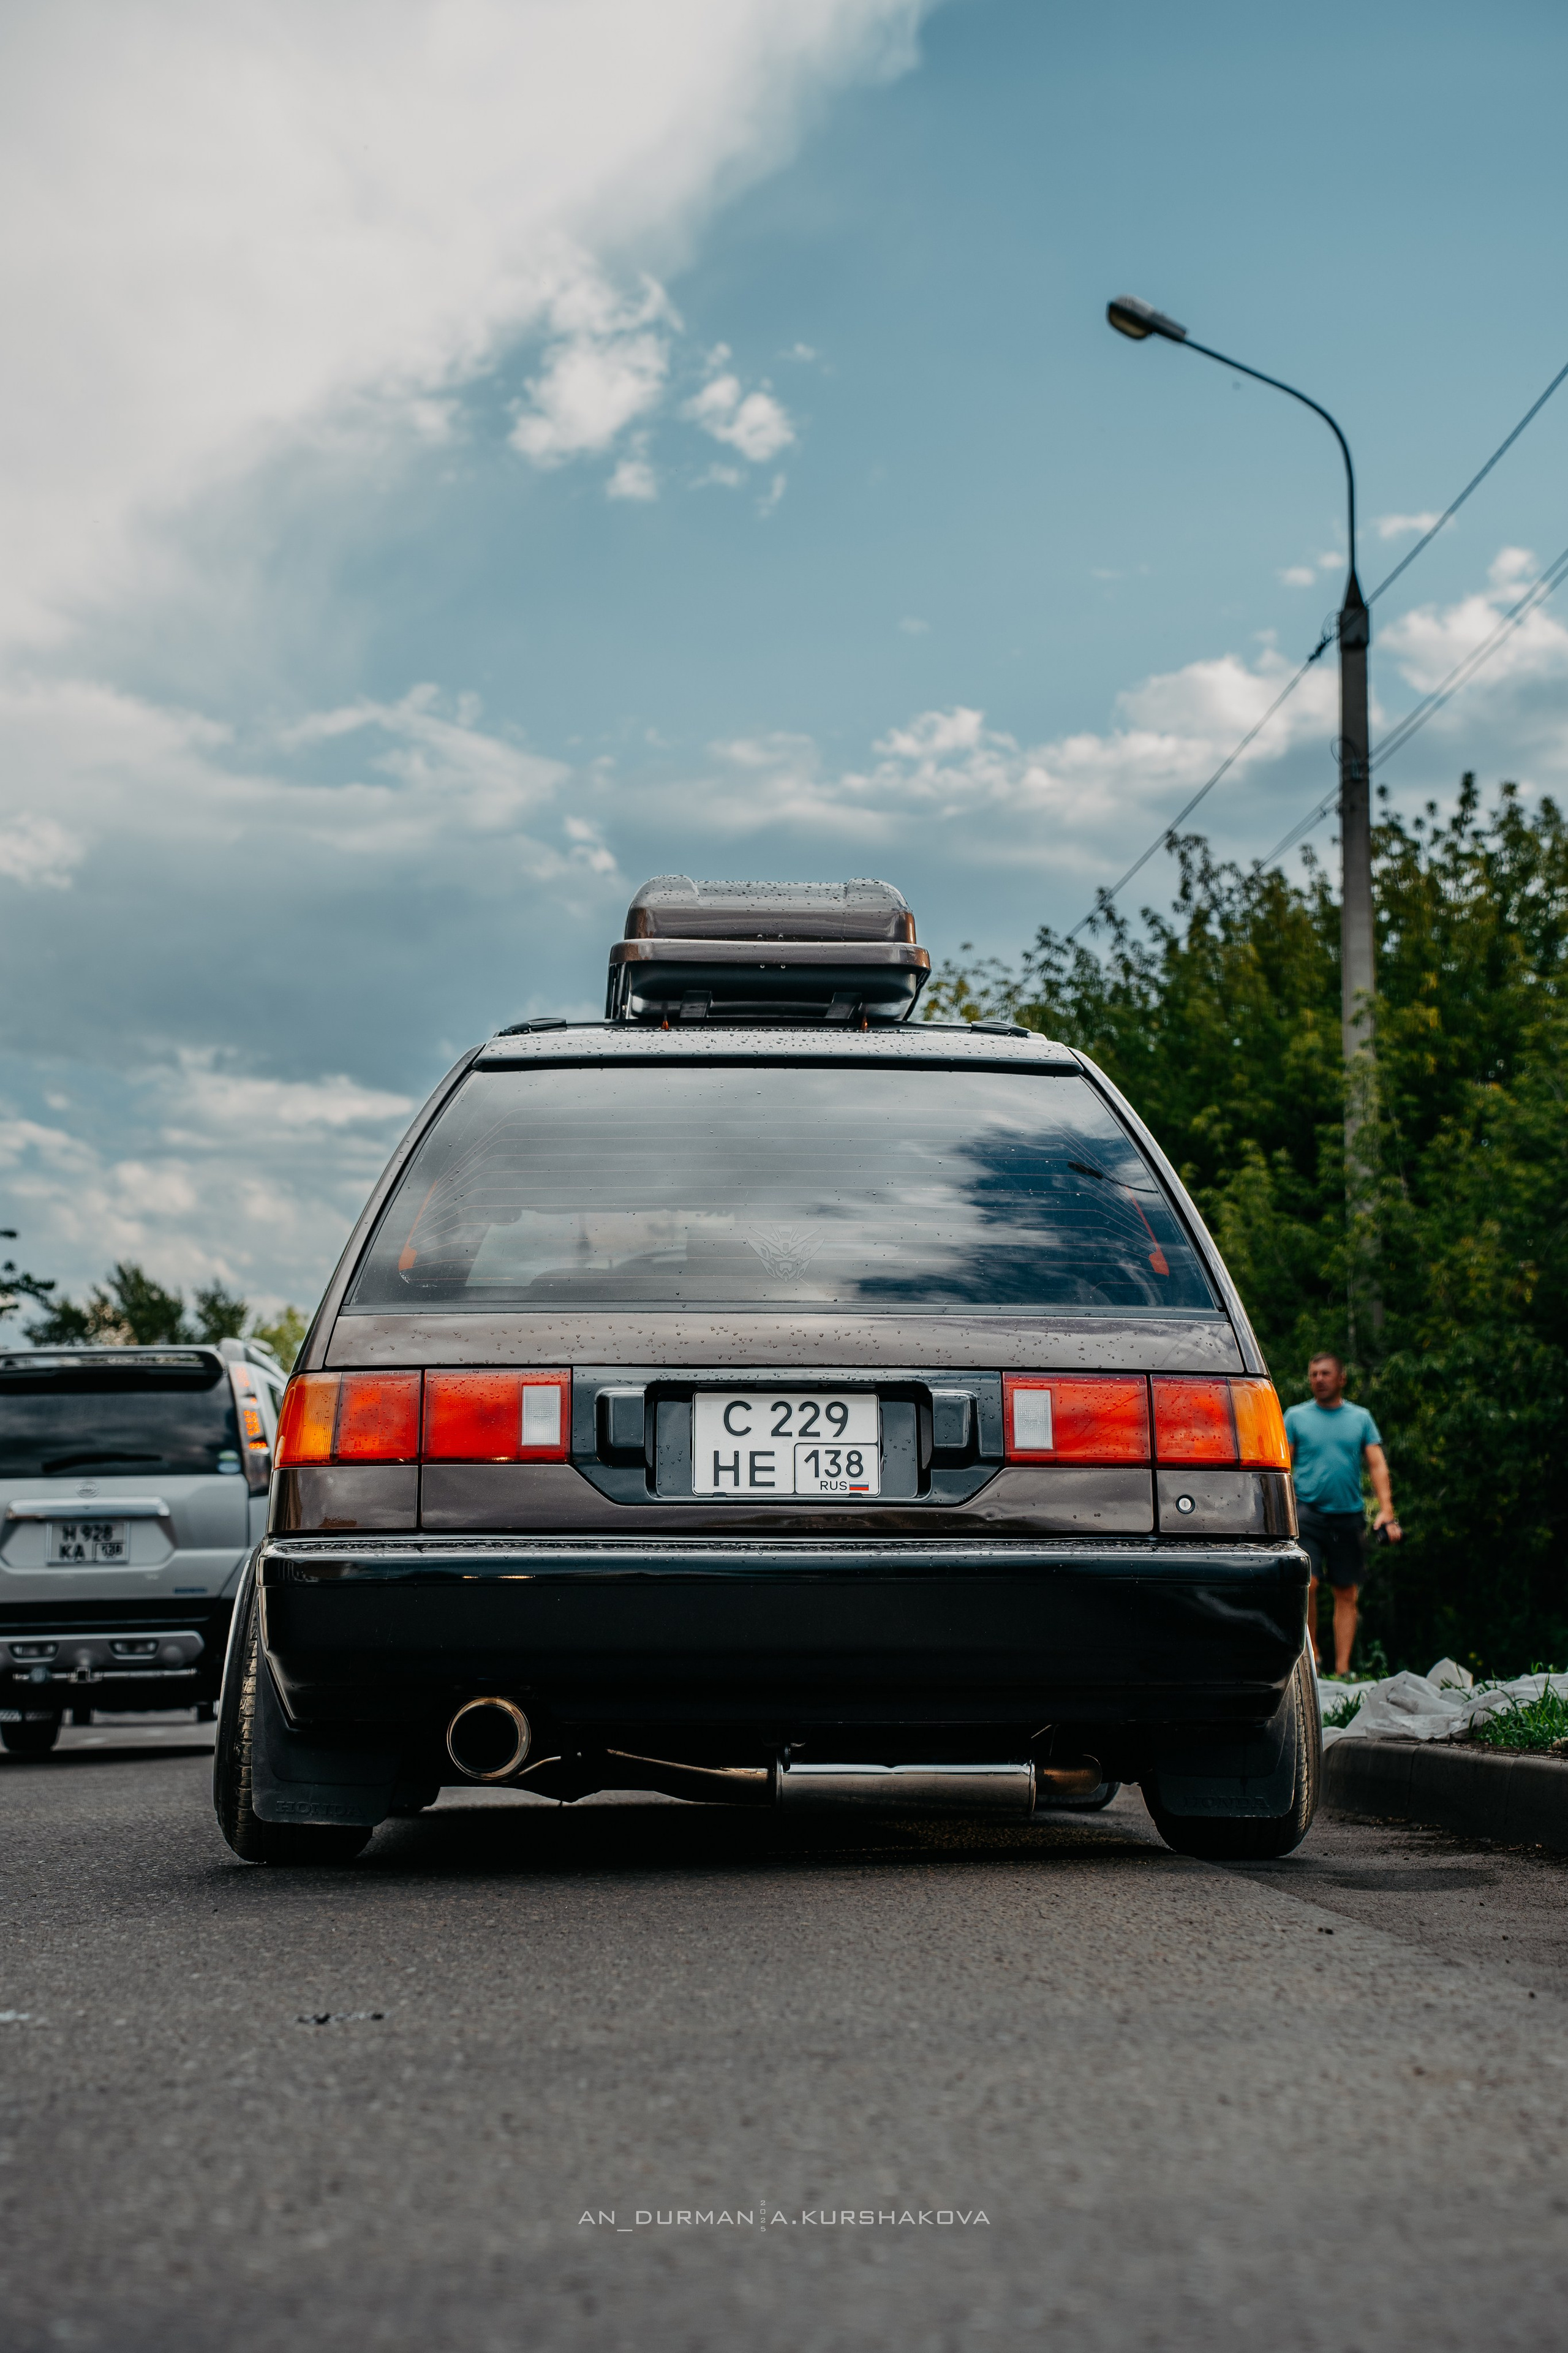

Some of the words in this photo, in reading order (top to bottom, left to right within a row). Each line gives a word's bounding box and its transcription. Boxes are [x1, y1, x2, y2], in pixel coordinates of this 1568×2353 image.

[723, 1400, 752, 1437] C
[771, 1400, 848, 1437] 229
[713, 1450, 775, 1487] HE
[804, 1449, 864, 1478] 138
[820, 1481, 847, 1490] RUS
[59, 1543, 85, 1561] KA
[276, 1800, 366, 1818] HONDA
[1184, 1795, 1270, 1810] HONDA
